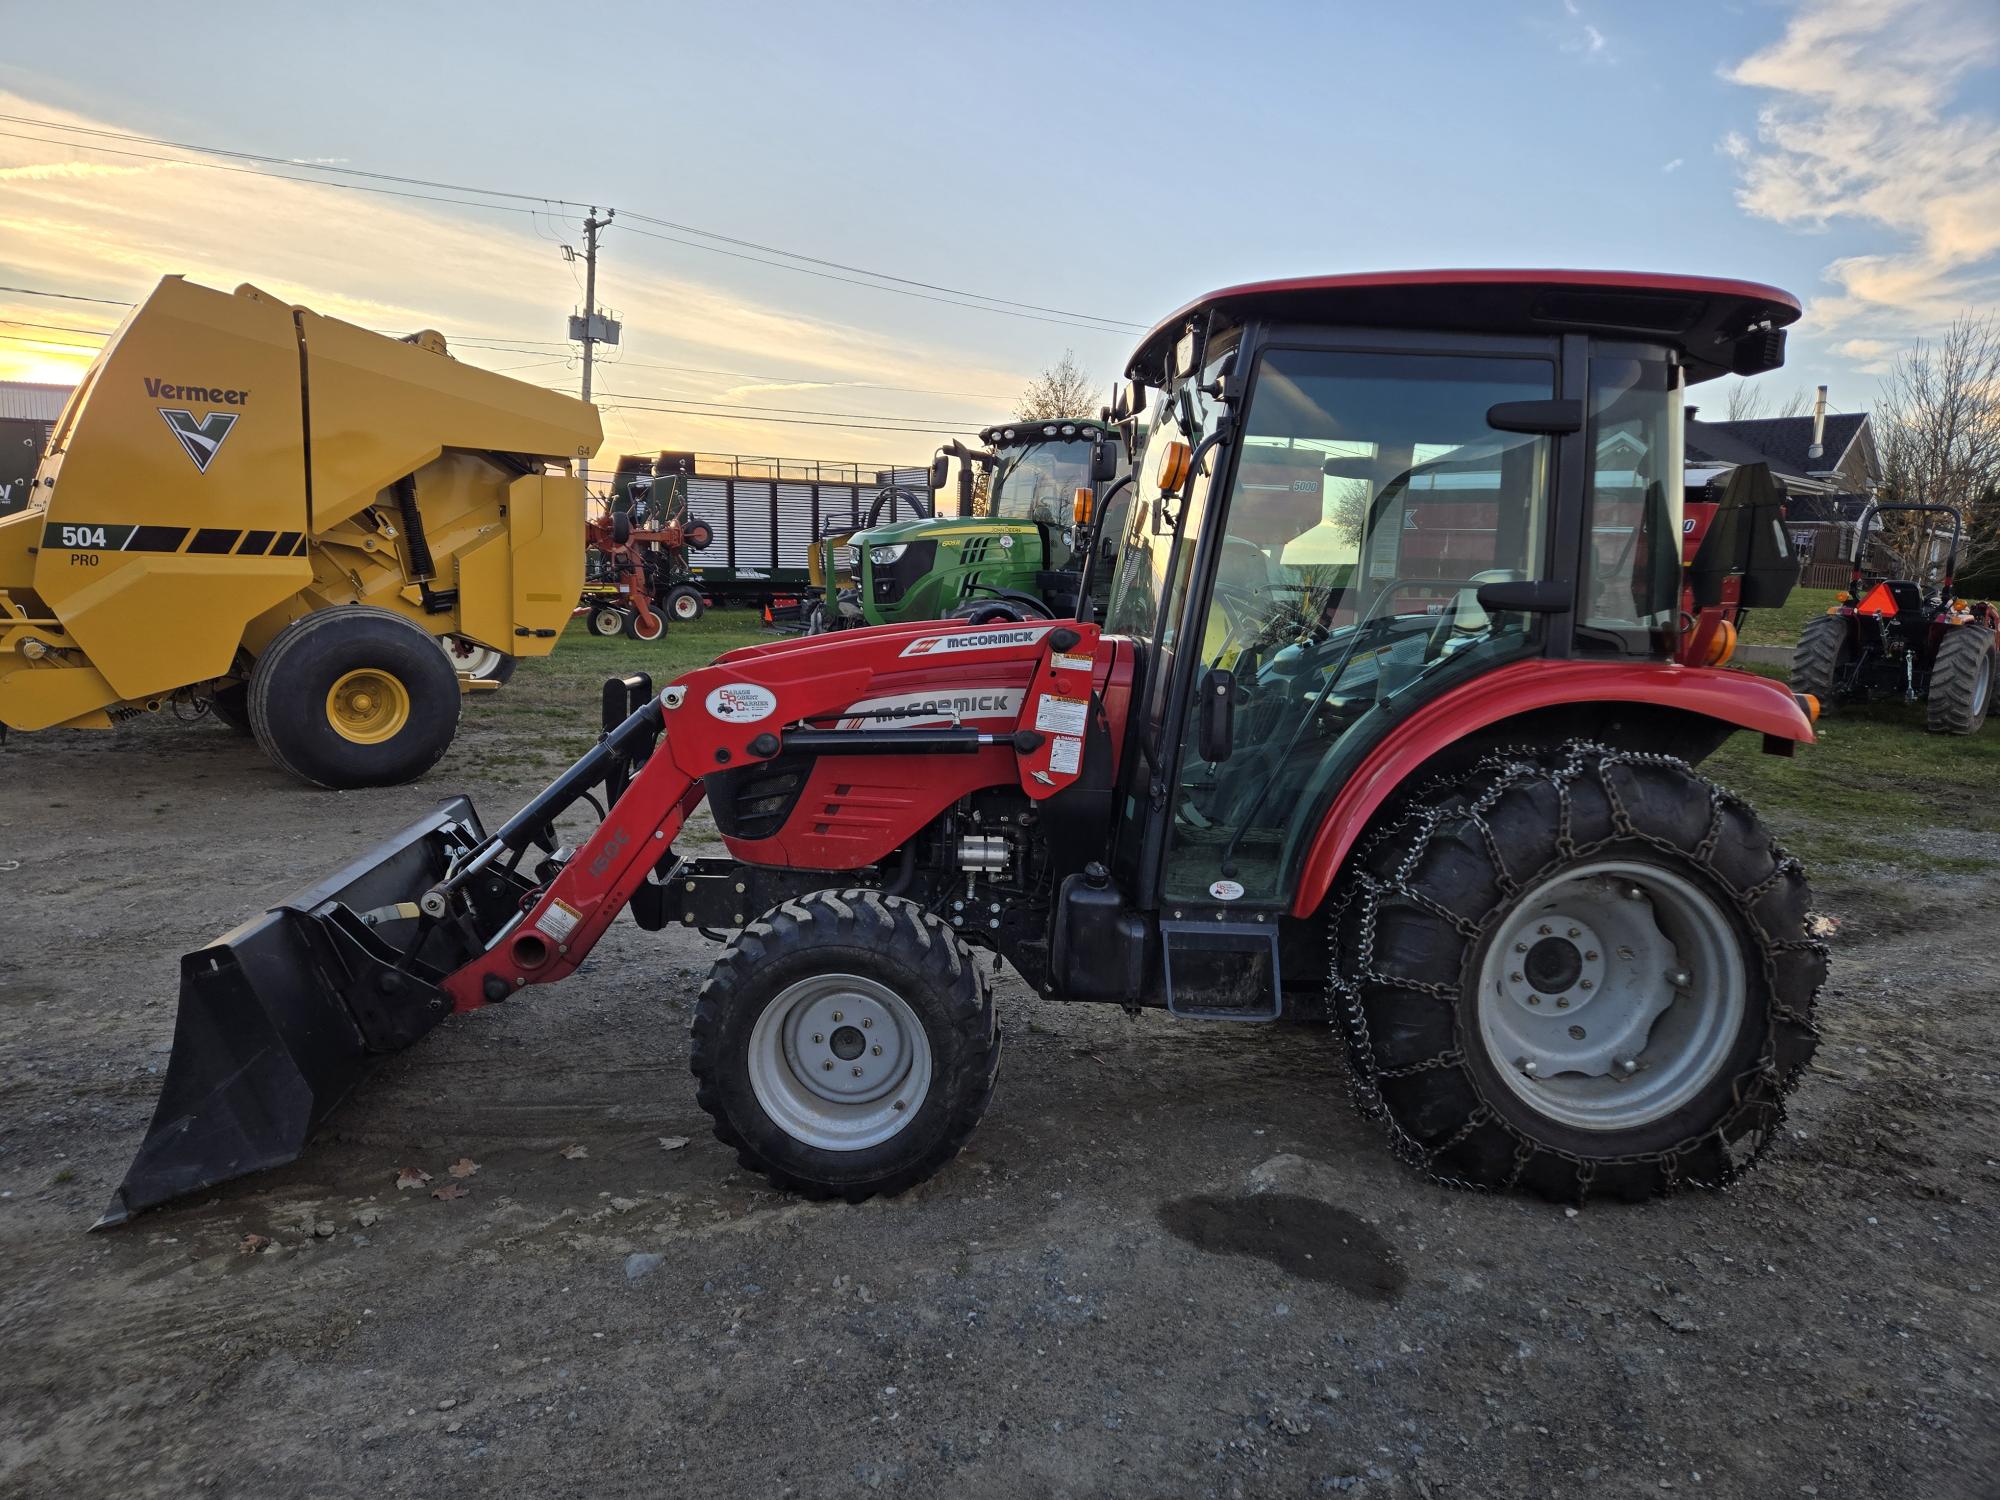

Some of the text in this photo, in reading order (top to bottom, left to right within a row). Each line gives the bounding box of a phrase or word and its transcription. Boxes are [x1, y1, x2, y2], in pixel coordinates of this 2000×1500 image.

[143, 377, 249, 406] Vermeer
[577, 445, 591, 456] G4
[1293, 480, 1318, 492] 5000
[62, 526, 107, 547] 504
[70, 553, 99, 567] PRO
